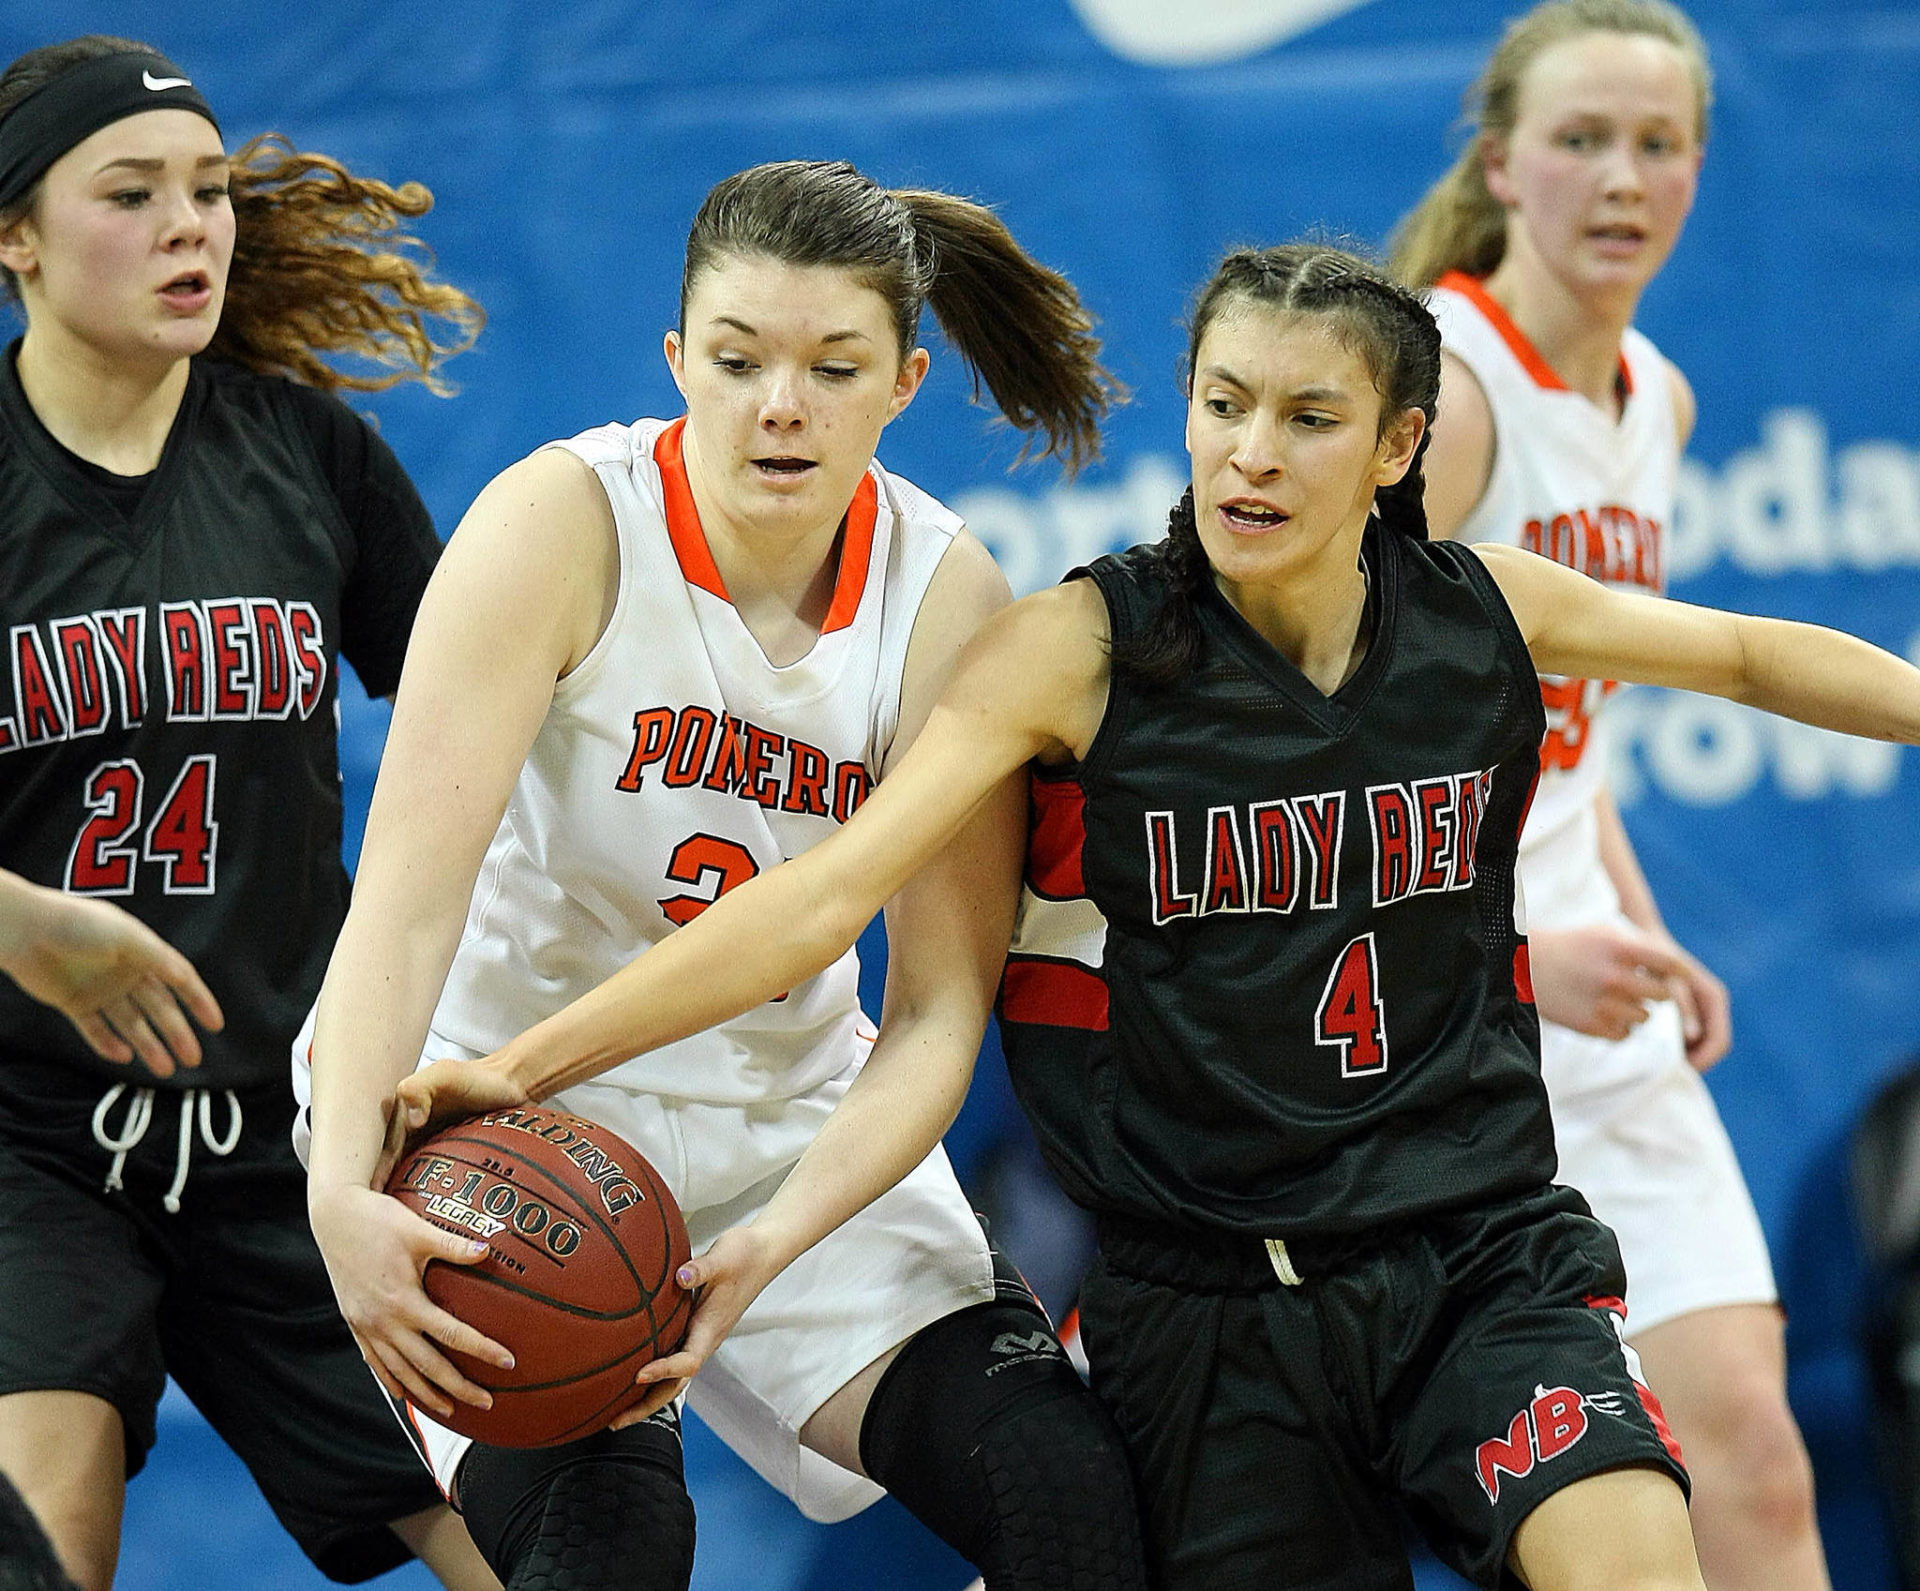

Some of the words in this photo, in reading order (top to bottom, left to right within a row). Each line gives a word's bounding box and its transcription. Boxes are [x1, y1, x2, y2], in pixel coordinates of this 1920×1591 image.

[0, 606, 148, 752] ADY
[160, 597, 327, 722] REDS
[64, 754, 218, 896] 24
[614, 704, 874, 826] POMERO
[1145, 791, 1346, 926] LADY
[1314, 931, 1388, 1078] 4
[402, 1156, 582, 1258] TF-1000
[425, 1194, 507, 1238] LEGACY
[480, 1109, 646, 1217] ALDING
[483, 1157, 515, 1177] 28.5
[1475, 1383, 1590, 1506] NB
